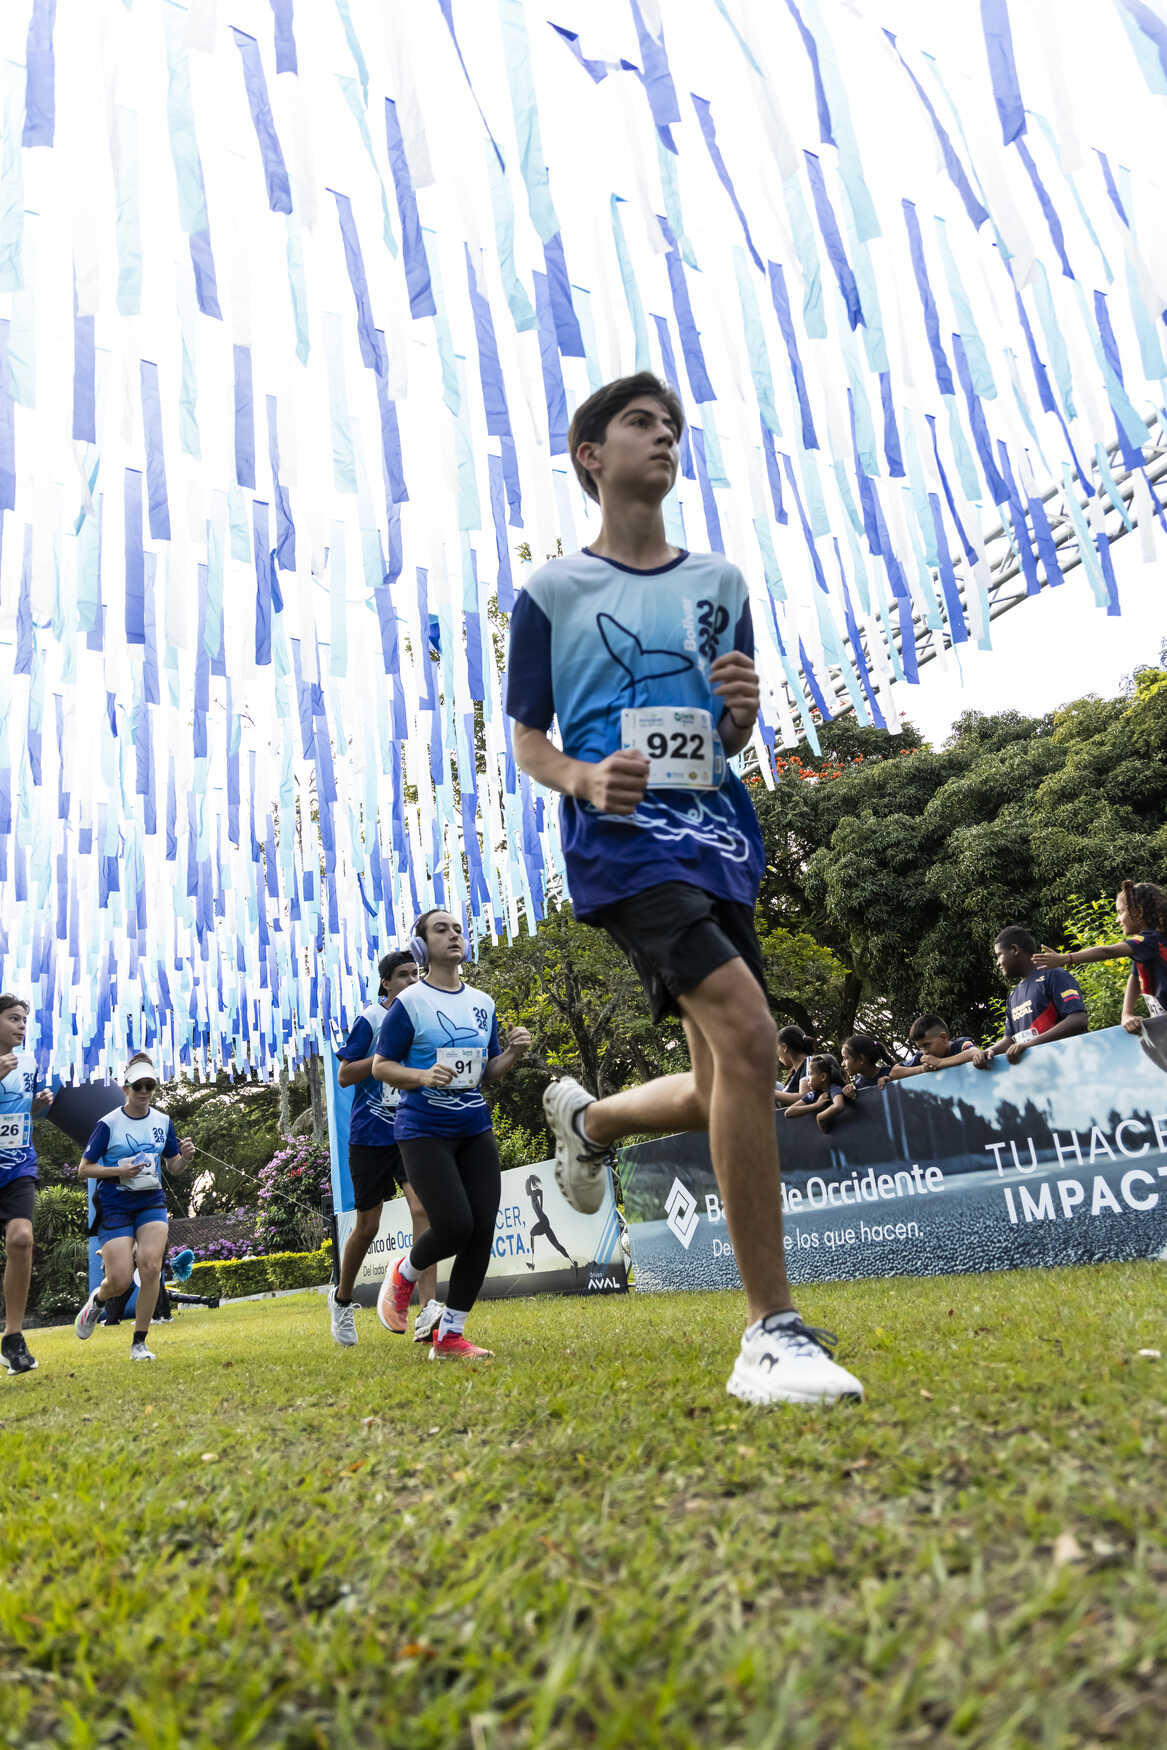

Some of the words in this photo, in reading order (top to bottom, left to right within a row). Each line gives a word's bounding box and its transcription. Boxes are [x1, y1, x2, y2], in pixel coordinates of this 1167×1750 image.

[696, 599, 730, 634] 20
[647, 732, 705, 761] 922
[455, 1059, 473, 1074] 91
[984, 1137, 1039, 1178] TU
[807, 1164, 945, 1208] Occidente
[386, 1233, 396, 1251] de
[796, 1228, 819, 1249] los
[824, 1228, 856, 1251] que
[860, 1221, 925, 1243] hacen.
[588, 1276, 621, 1291] AVAL
